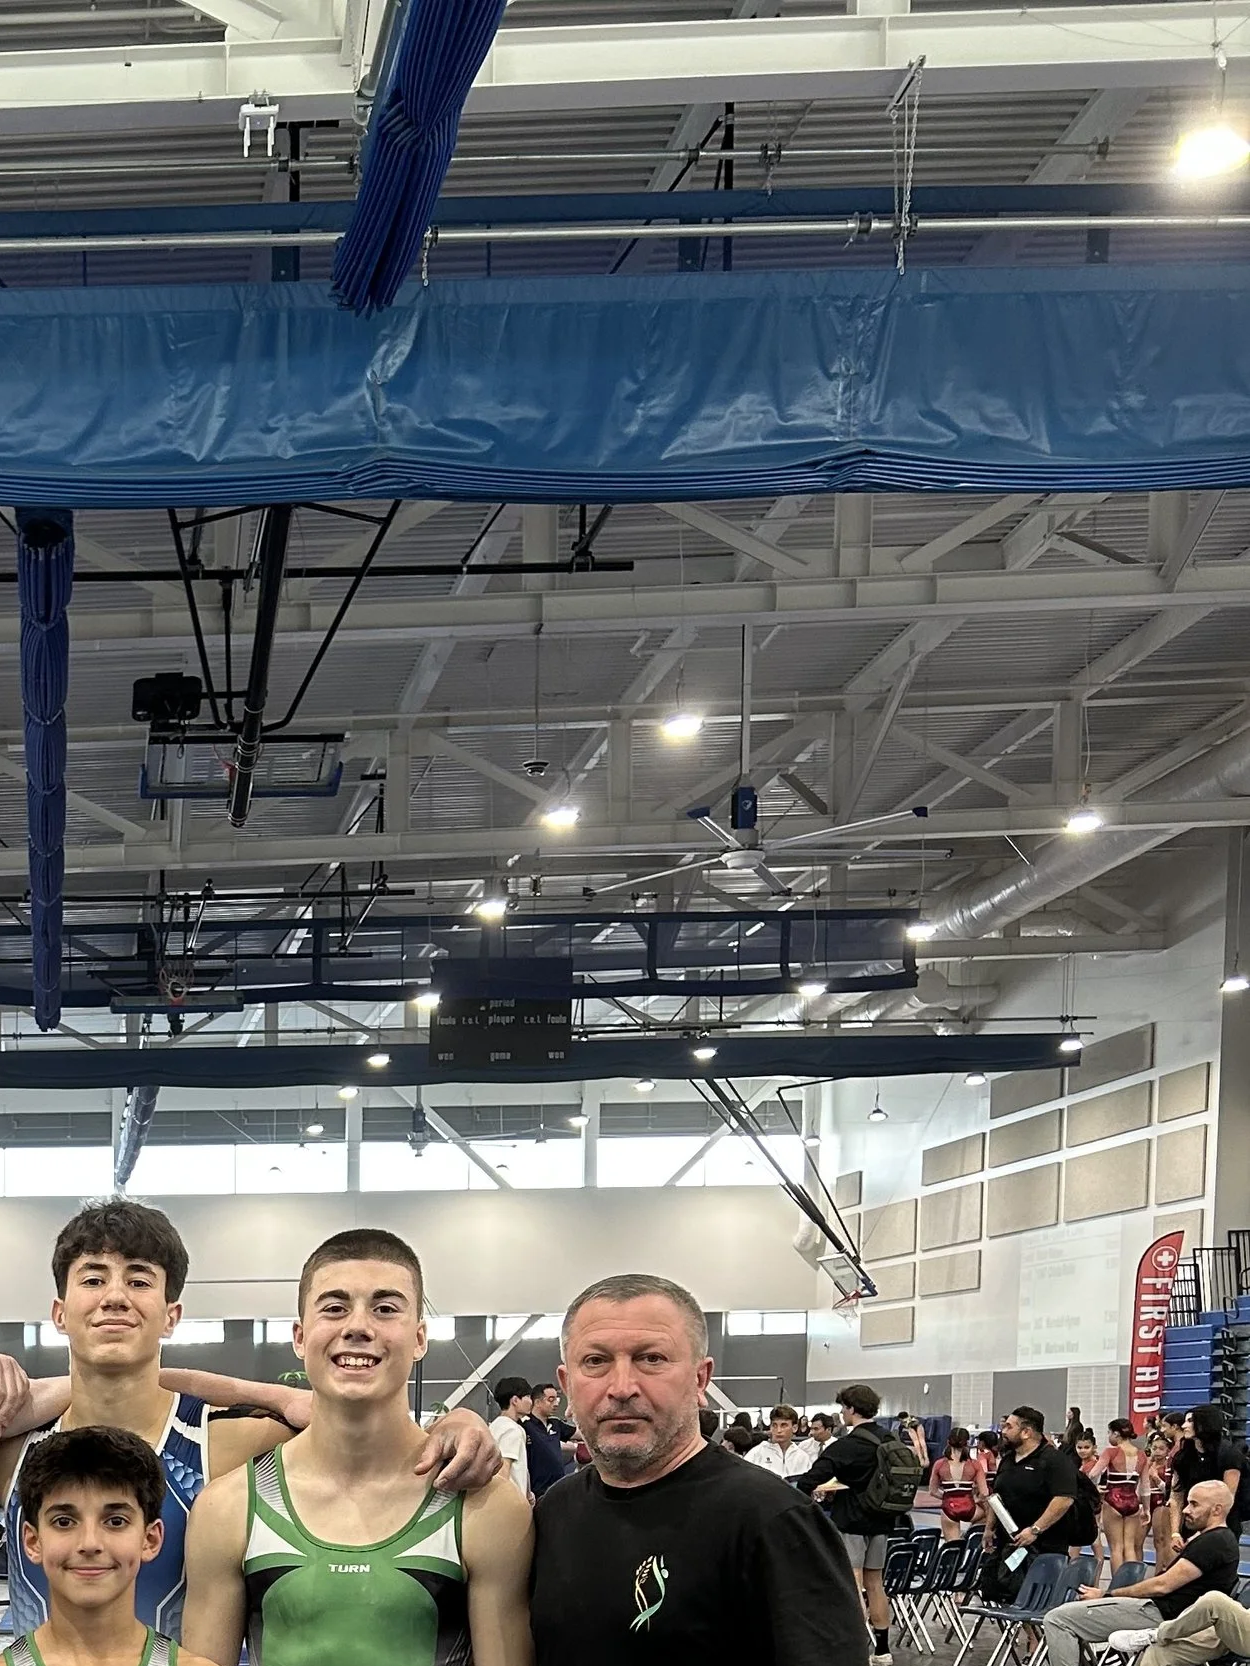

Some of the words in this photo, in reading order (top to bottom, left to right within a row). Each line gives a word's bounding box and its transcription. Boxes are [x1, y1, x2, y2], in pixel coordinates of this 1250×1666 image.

[488, 1014, 515, 1026] player
[1137, 1277, 1174, 1356] FIRST
[1133, 1366, 1161, 1413] AID
[328, 1563, 371, 1573] TURN
